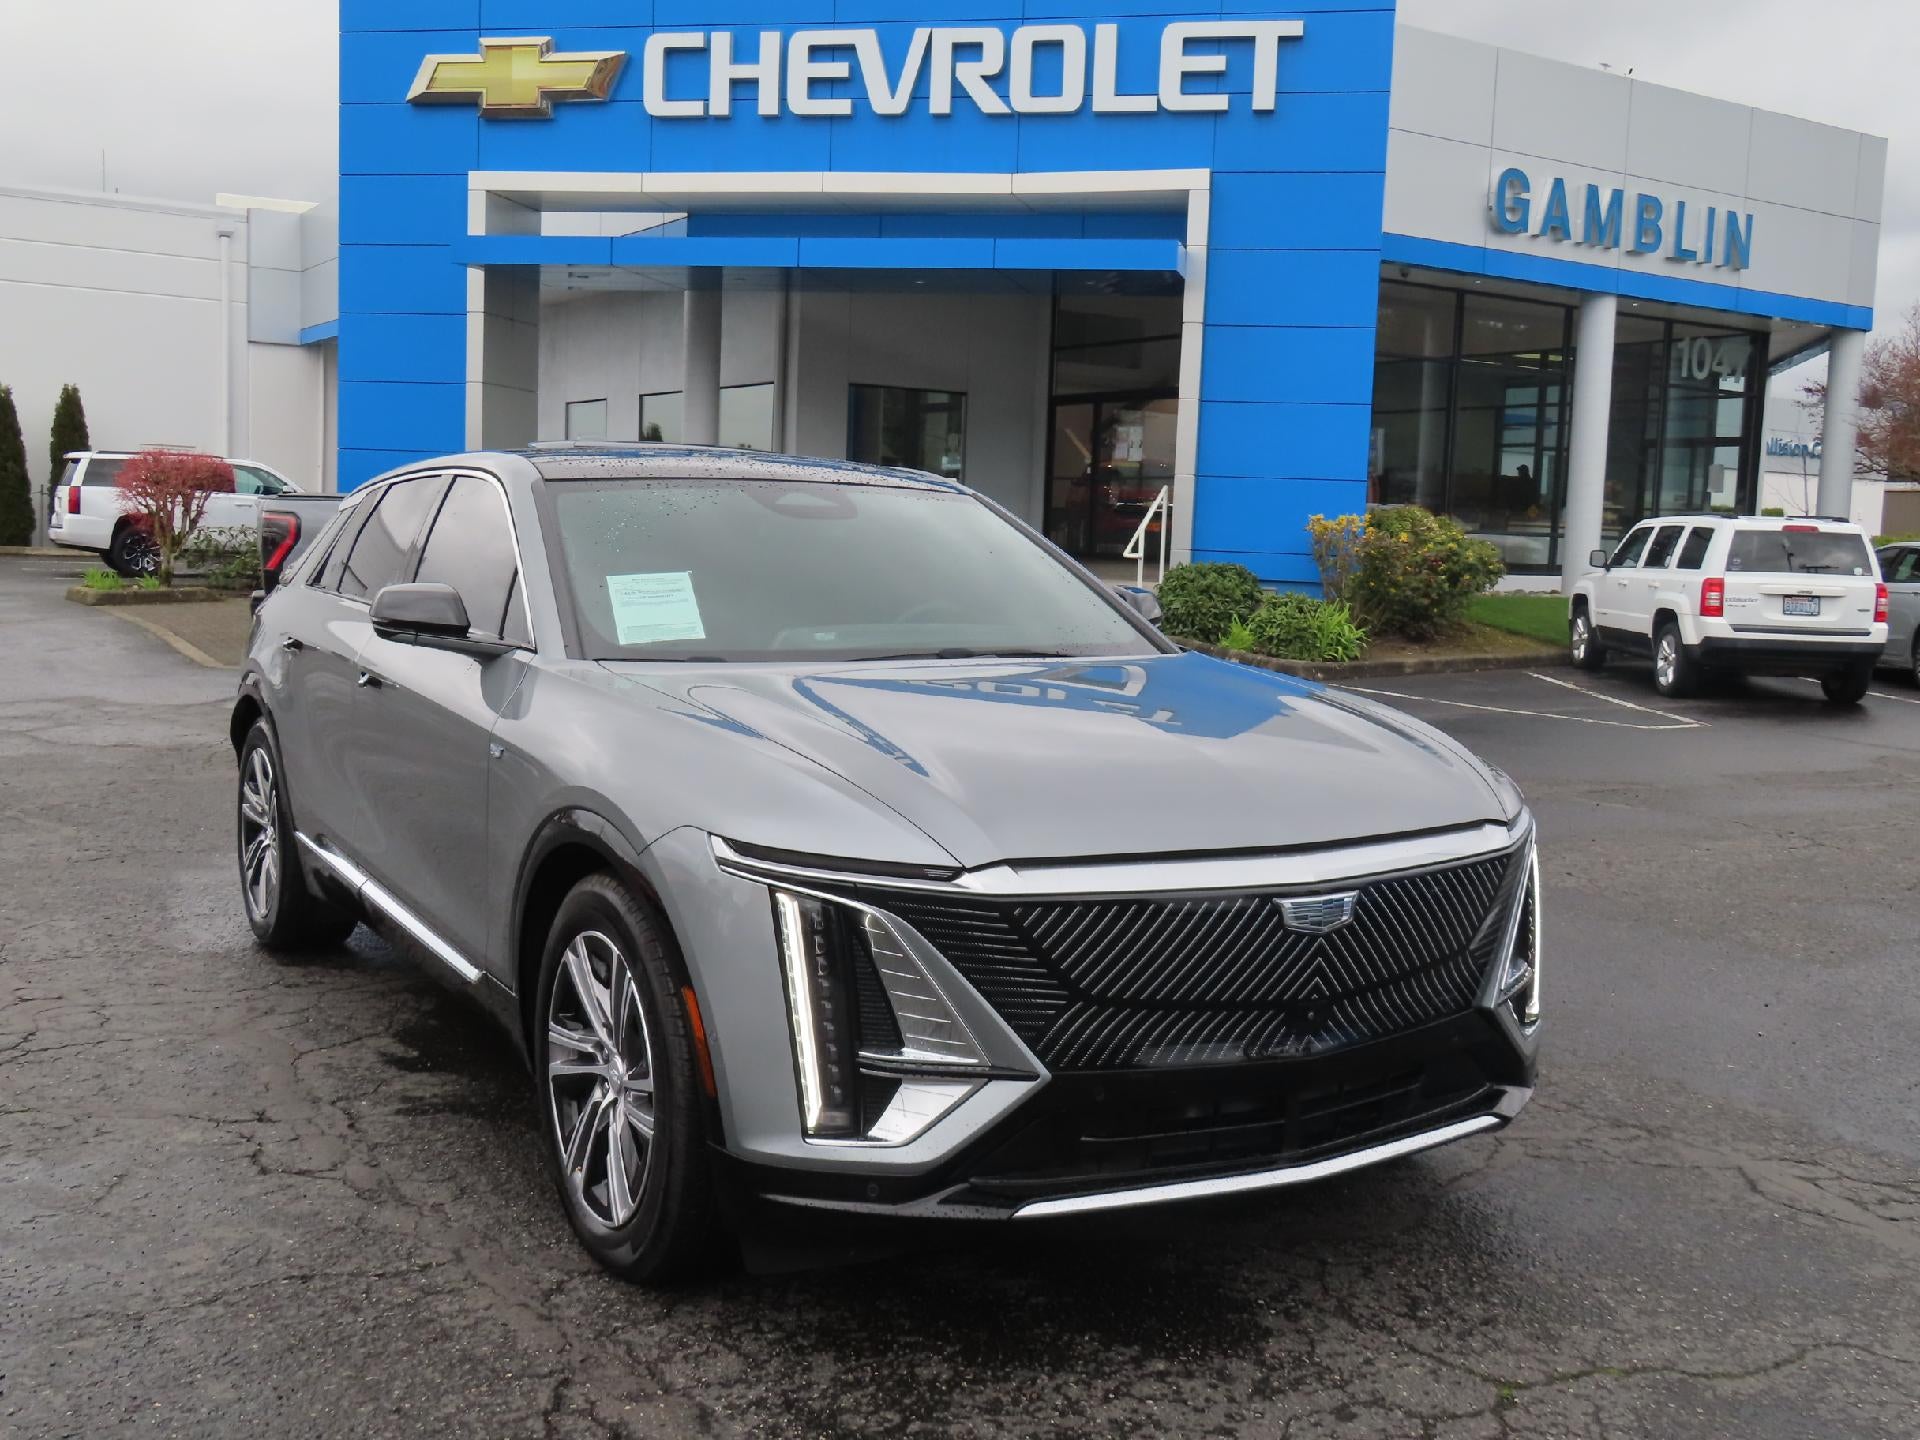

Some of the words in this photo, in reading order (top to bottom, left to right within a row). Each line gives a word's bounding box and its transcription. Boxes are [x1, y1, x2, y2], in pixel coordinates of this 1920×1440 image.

[643, 20, 1304, 118] CHEVROLET
[1491, 168, 1754, 270] GAMBLIN
[1677, 336, 1752, 383] 1047
